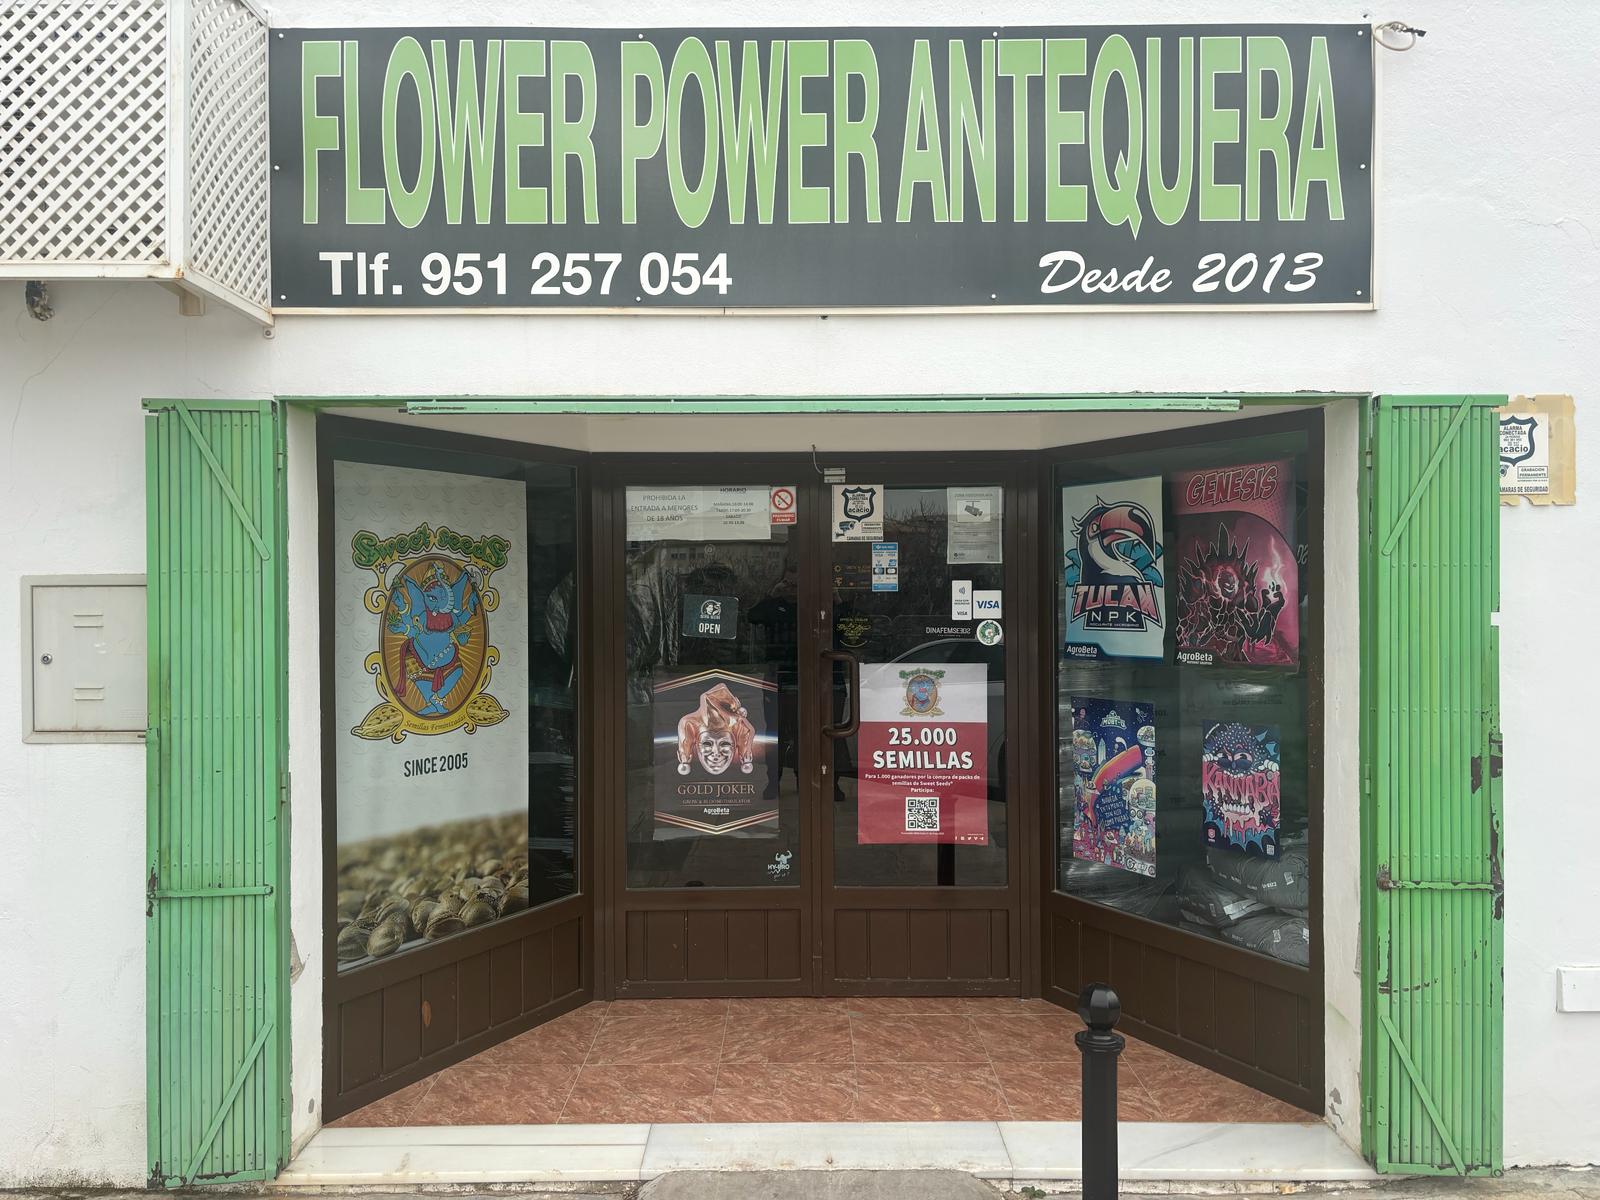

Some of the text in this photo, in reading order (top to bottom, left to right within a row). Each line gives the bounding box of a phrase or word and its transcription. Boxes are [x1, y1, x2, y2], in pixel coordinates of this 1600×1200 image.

[301, 34, 1345, 239] FLOWER POWER ANTEQUERA
[319, 252, 732, 295] Tlf. 951 257 054
[1038, 251, 1324, 294] Desde 2013
[1186, 465, 1278, 507] GENESIS
[352, 522, 432, 568] Sweet
[976, 600, 1000, 609] VISA
[1073, 584, 1157, 616] TUCAN
[698, 622, 721, 634] OPEN
[1066, 645, 1097, 655] AgroBeta
[1176, 651, 1213, 662] AgroBeta
[888, 727, 957, 746] 25.000
[404, 752, 468, 777] SINCE 2005
[873, 750, 973, 770] SEMILLAS
[677, 784, 756, 797] GOLD JOKER
